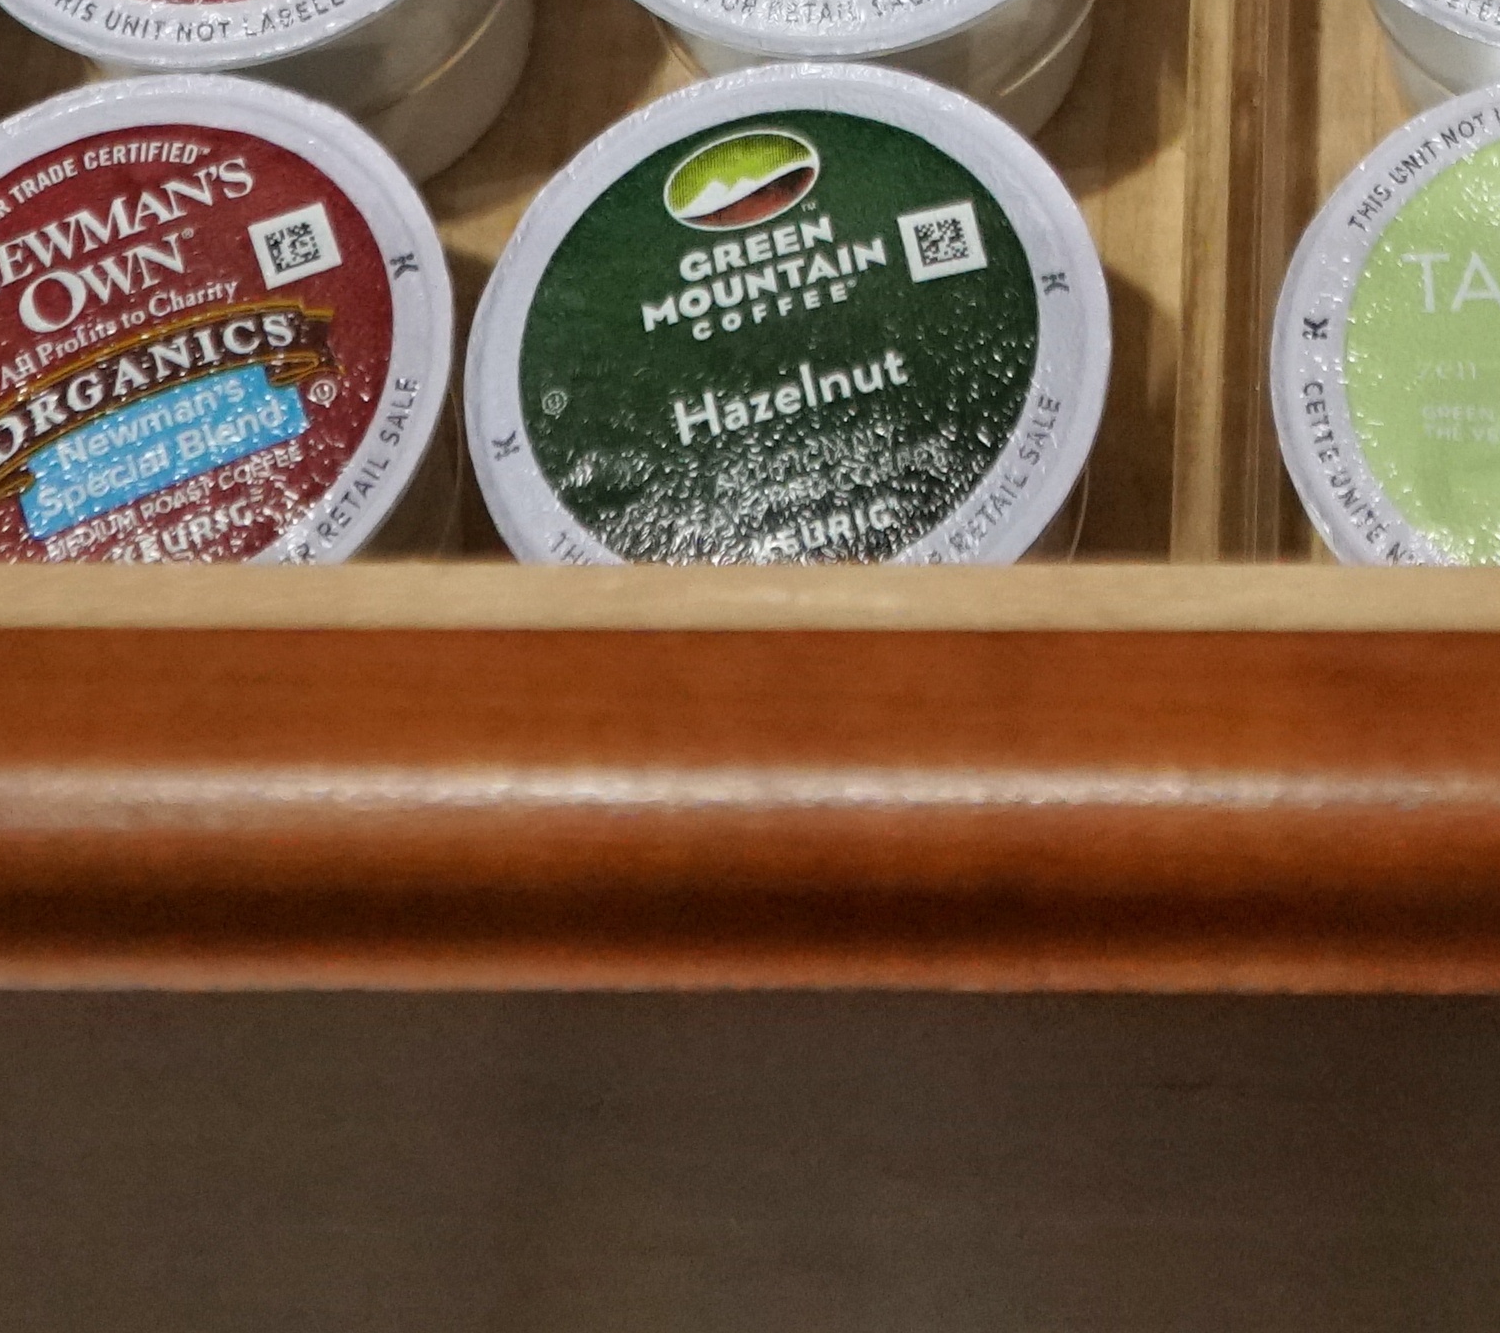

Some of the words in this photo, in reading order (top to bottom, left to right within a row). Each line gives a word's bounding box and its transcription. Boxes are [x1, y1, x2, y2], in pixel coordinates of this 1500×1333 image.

[13, 159, 79, 209] TRADE
[81, 143, 201, 171] CERTIFIED
[1346, 185, 1391, 234] THIS
[1443, 116, 1490, 152] NOT
[17, 230, 185, 340] OWN
[641, 235, 889, 333] MOUNTAIN
[677, 217, 835, 285] GREEN
[690, 283, 850, 343] COFFEE
[671, 352, 912, 449] Hazelnut
